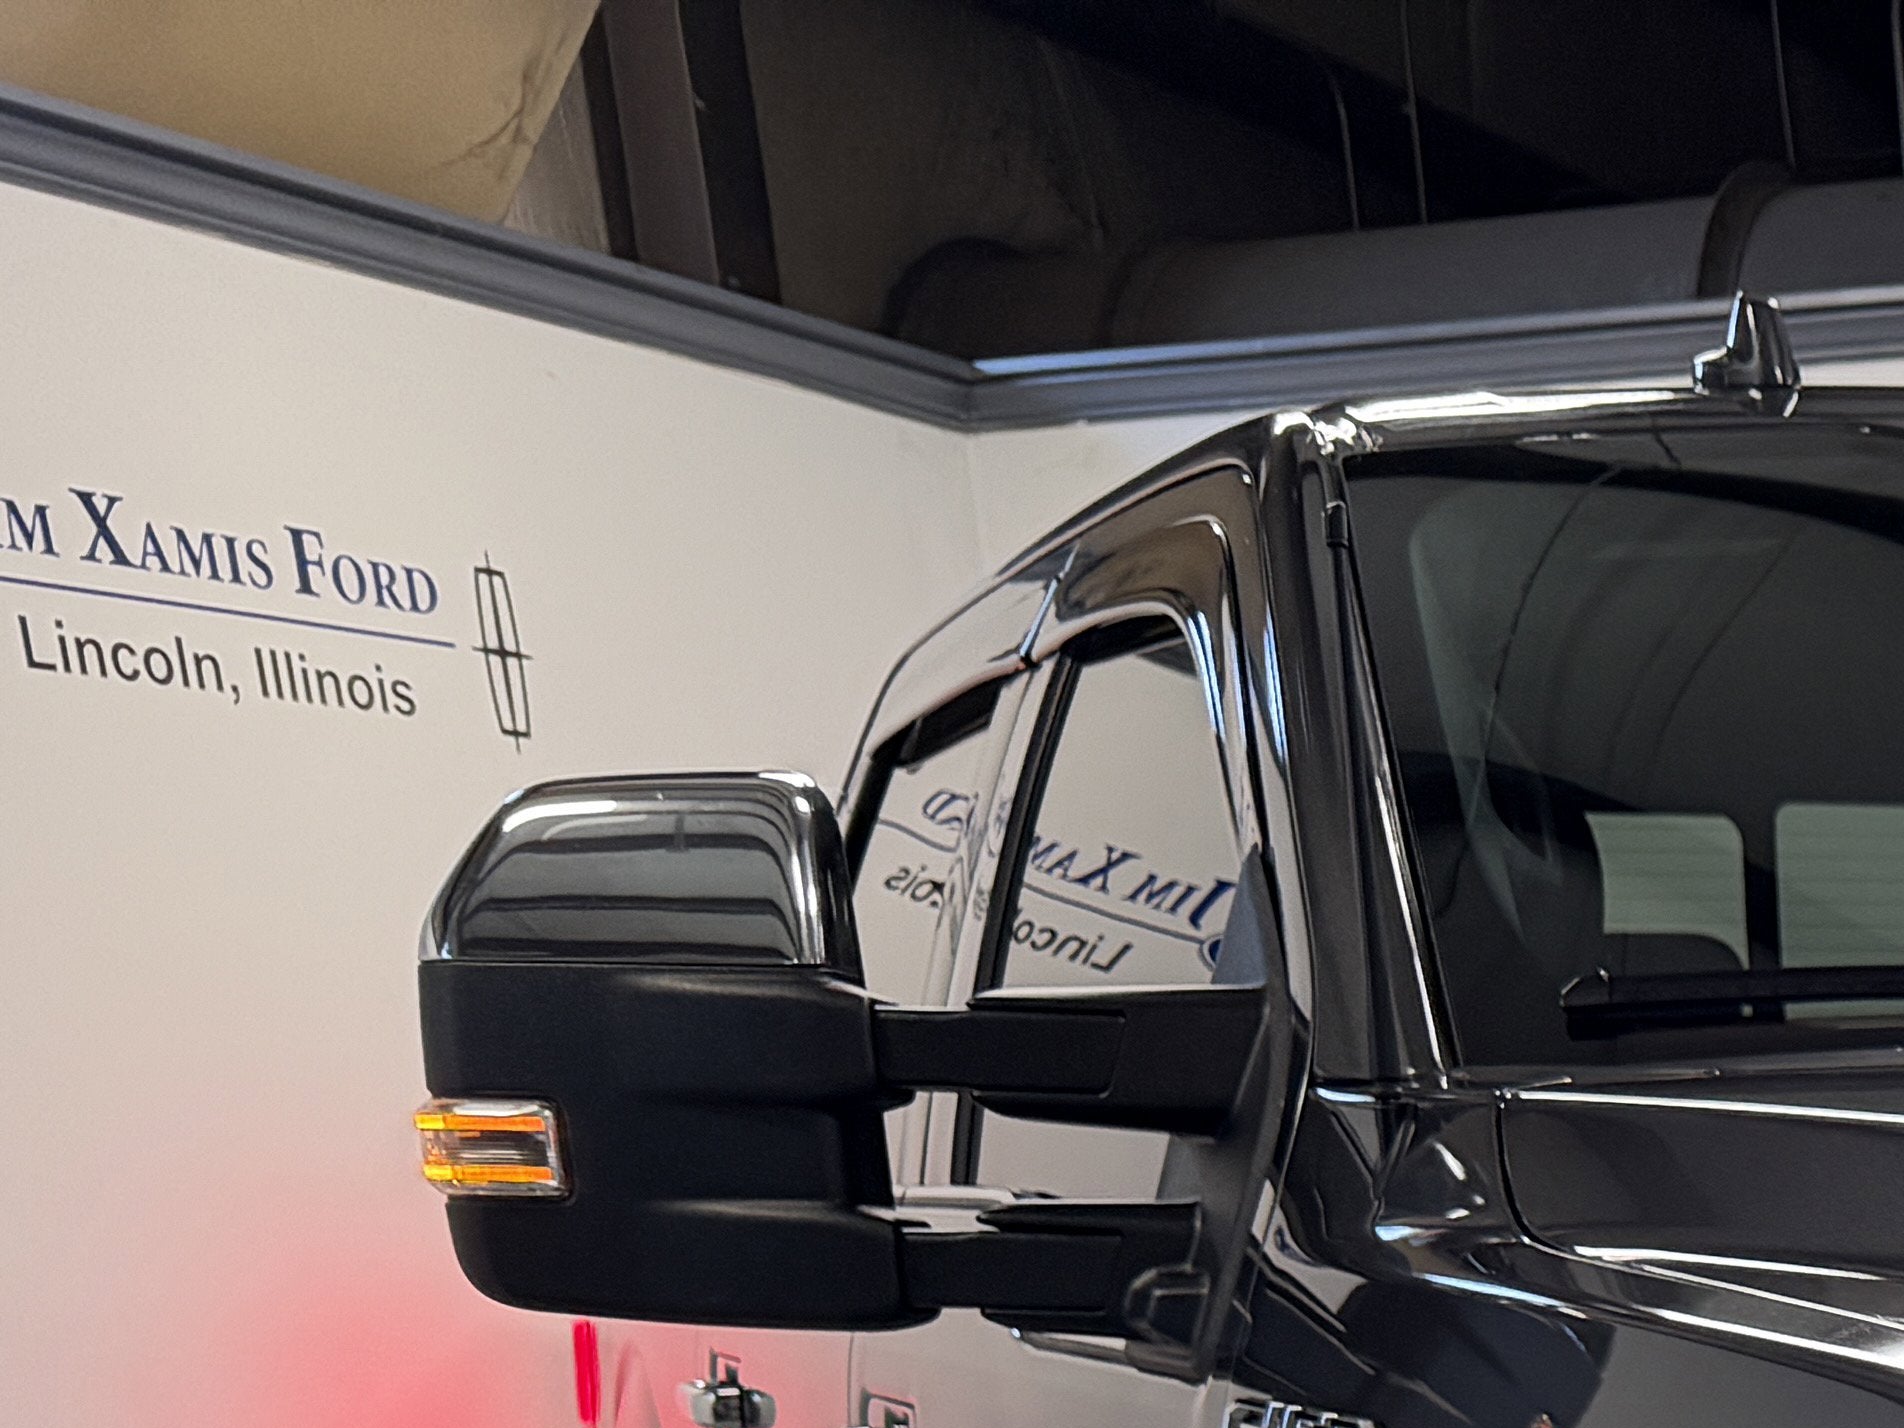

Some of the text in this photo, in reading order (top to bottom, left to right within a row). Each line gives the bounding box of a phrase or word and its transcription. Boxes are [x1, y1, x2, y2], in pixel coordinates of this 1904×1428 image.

[68, 488, 273, 589] XAMIS
[284, 525, 437, 614] FORD
[18, 615, 416, 716] Lincoln, Illinois
